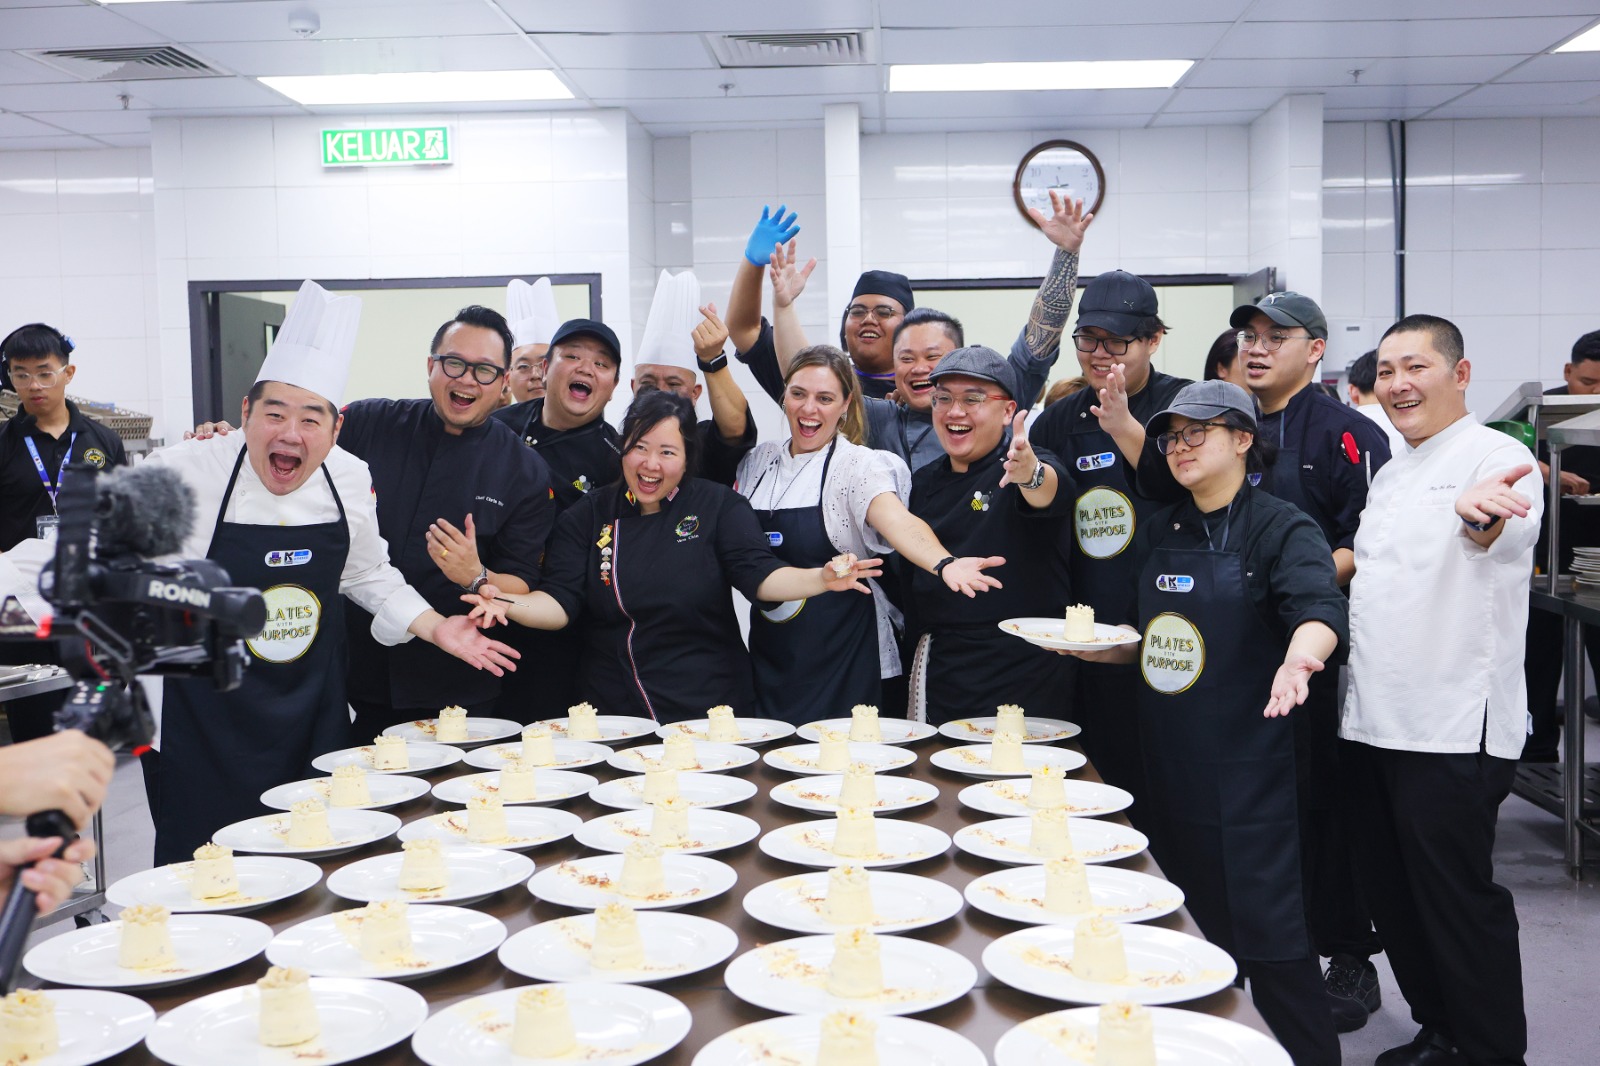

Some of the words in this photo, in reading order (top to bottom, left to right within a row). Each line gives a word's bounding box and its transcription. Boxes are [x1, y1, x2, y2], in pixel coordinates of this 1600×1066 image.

[326, 131, 420, 162] KELUAR
[1079, 505, 1125, 522] PLATES
[1080, 524, 1127, 539] PURPOSE
[148, 580, 211, 608] RONIN
[265, 604, 312, 622] LATES
[1150, 634, 1194, 653] PLATES
[1146, 655, 1194, 672] PURPOSE
